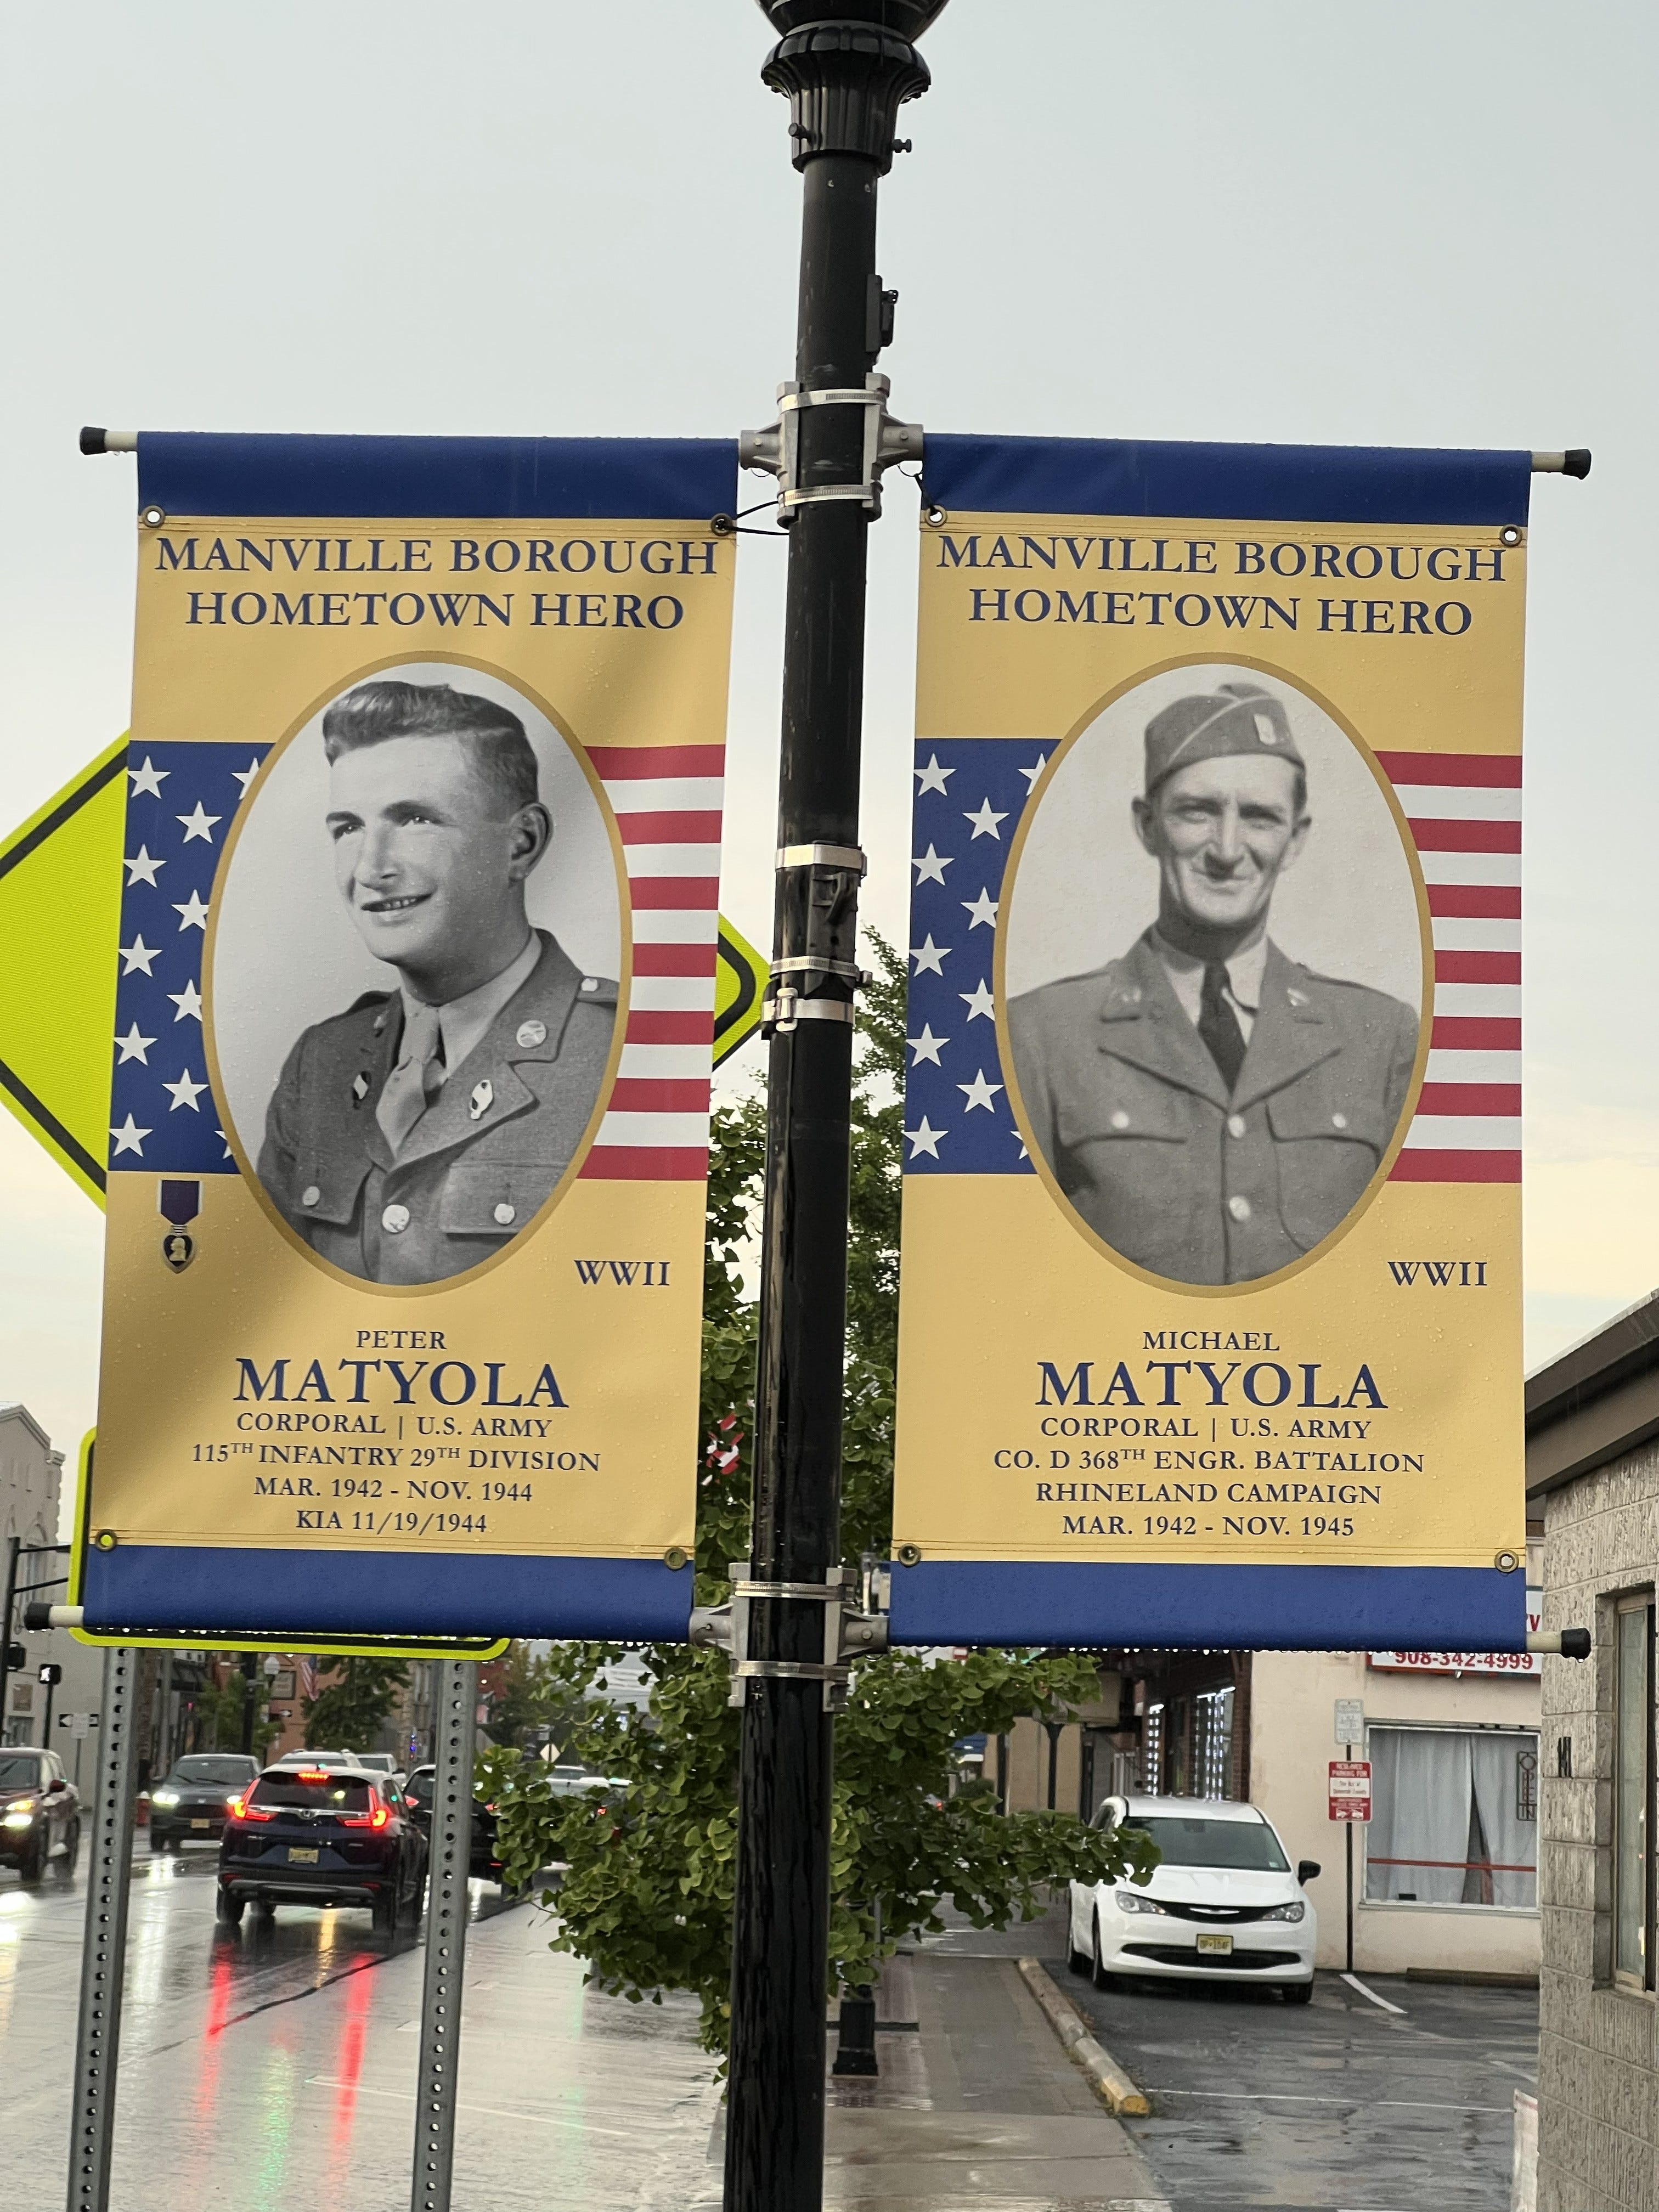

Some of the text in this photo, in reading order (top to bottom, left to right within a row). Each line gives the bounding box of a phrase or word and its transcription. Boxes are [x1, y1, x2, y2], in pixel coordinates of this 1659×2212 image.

[155, 537, 719, 575] MANVILLE BOROUGH
[936, 535, 1507, 582] MANVILLE BOROUGH
[185, 591, 684, 630] HOMETOWN HERO
[968, 588, 1472, 636] HOMETOWN HERO
[573, 1260, 671, 1286] WWII
[1387, 1261, 1488, 1286] WWII
[356, 1330, 448, 1350] PETER
[1142, 1331, 1280, 1351] MICHAEL
[232, 1357, 570, 1409] MATYOLA
[1034, 1361, 1390, 1409] MATYOLA
[236, 1412, 387, 1434] CORPORAL
[416, 1416, 463, 1436] U.S.
[470, 1417, 552, 1438] ARMY
[1040, 1417, 1199, 1437] CORPORAL
[1229, 1417, 1279, 1437] U.S.
[1286, 1419, 1372, 1440] ARMY
[192, 1442, 601, 1472] 115TH INFANTRY 29TH DIVISION
[994, 1448, 1425, 1473] CO. D 368TH ENGR. BATTALION
[253, 1476, 321, 1497] MAR.
[331, 1478, 383, 1498] 1942
[407, 1480, 472, 1501] NOV.
[482, 1482, 533, 1503] 1944
[1035, 1482, 1382, 1505] RHINELAND CAMPAIGN
[295, 1509, 487, 1537] KIA 11/19/1944
[1062, 1515, 1133, 1536] MAR.
[1143, 1515, 1197, 1536] 1942
[1221, 1516, 1290, 1536] NOV.
[1300, 1516, 1355, 1537] 1945
[1395, 1652, 1533, 1670] 908-342-4999
